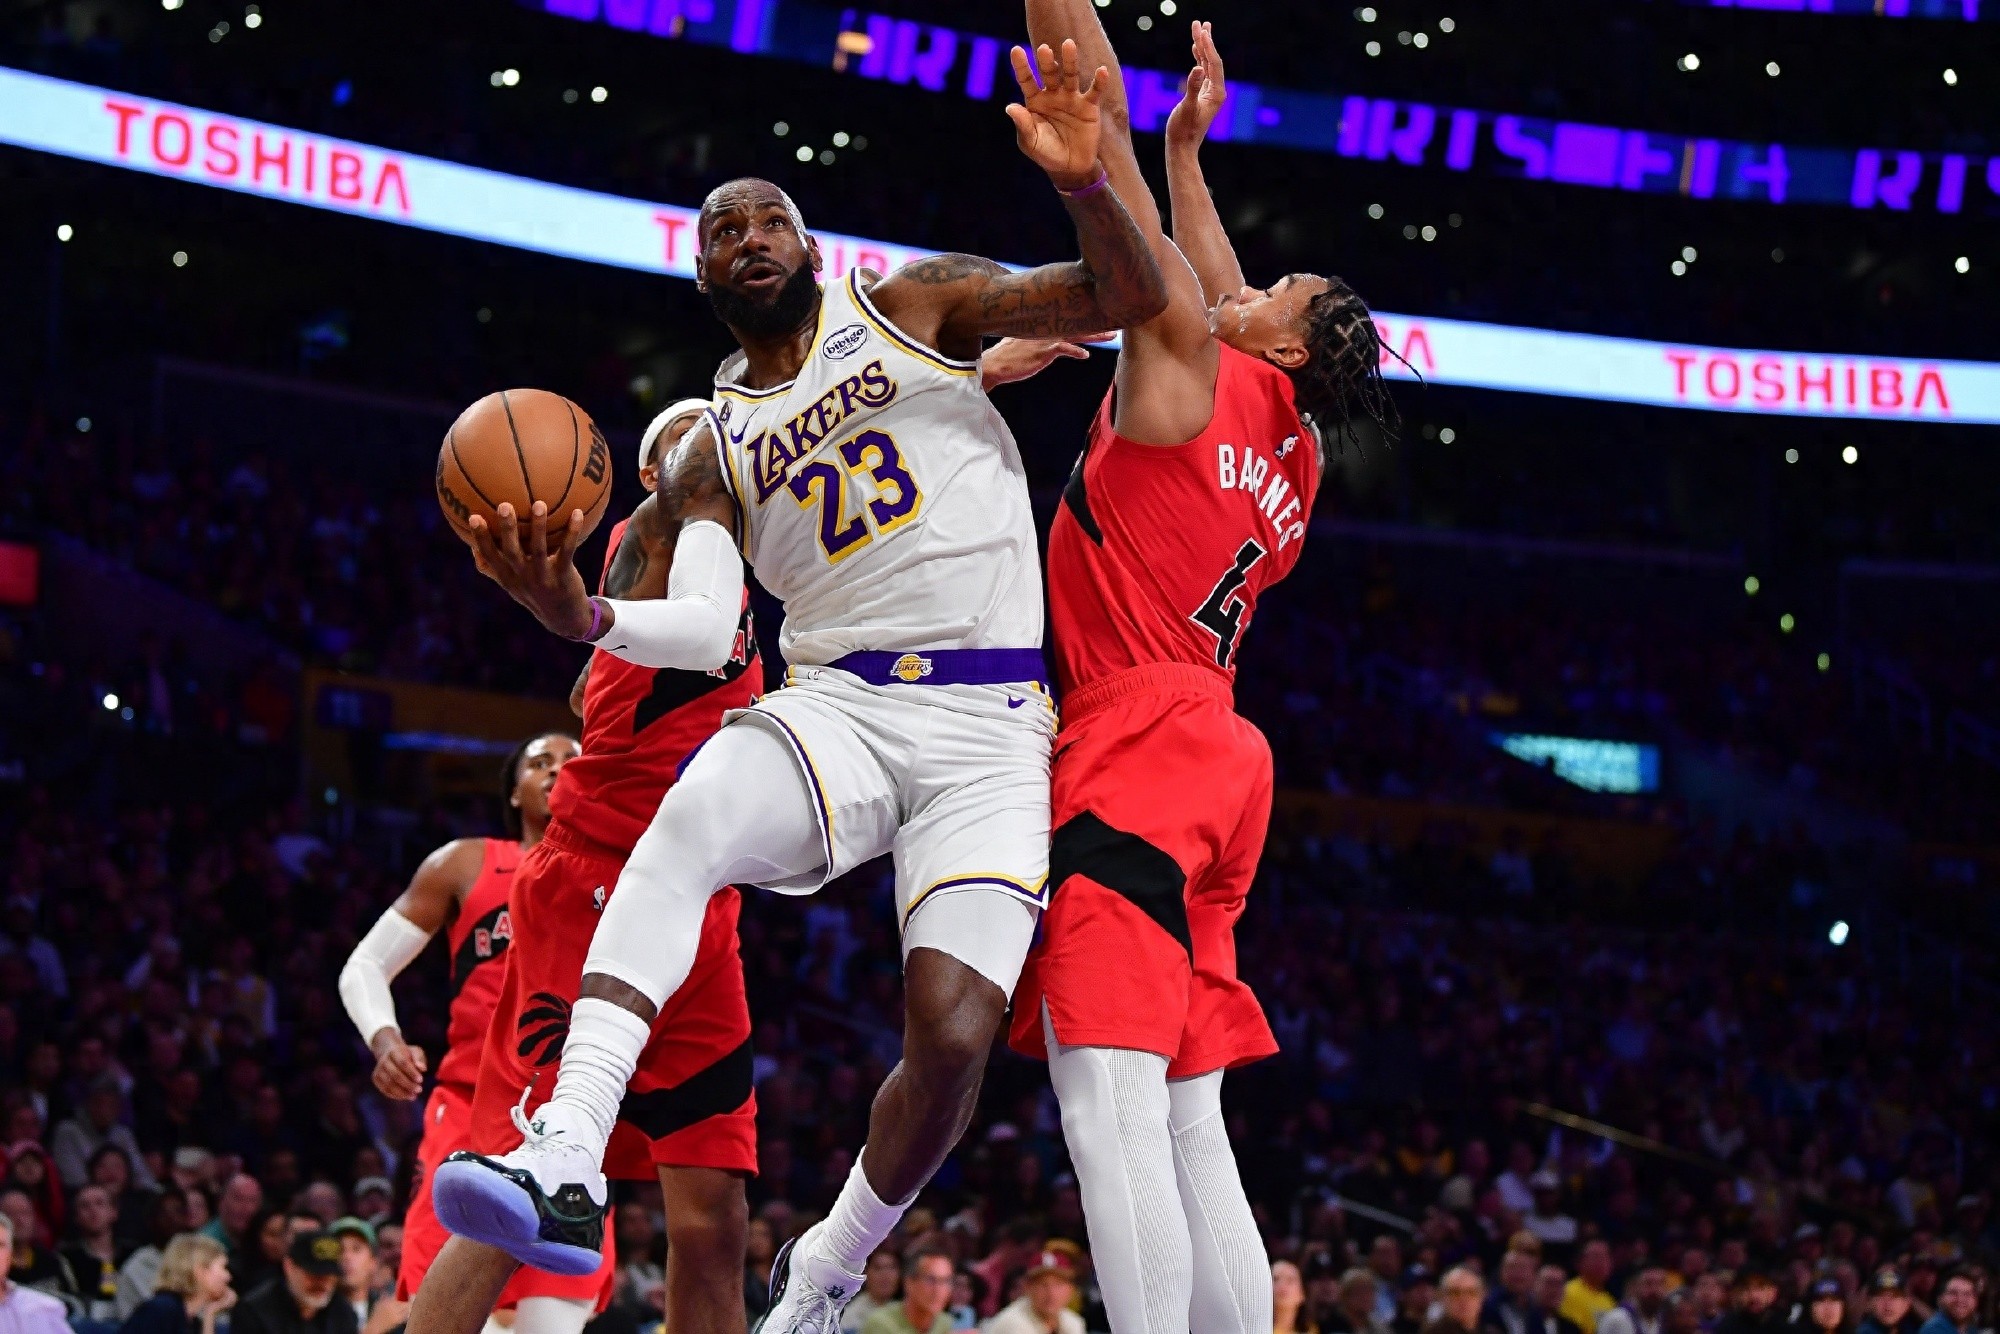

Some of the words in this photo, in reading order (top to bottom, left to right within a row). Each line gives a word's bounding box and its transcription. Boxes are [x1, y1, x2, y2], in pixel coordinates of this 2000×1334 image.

[104, 101, 411, 212] TOSHIBA
[826, 328, 864, 354] bibigo
[1666, 352, 1950, 412] TOSHIBA
[746, 358, 898, 507] LAKERS
[786, 427, 924, 565] 23
[1217, 444, 1304, 551] BARNES
[1188, 537, 1268, 670] 4
[892, 661, 932, 675] LAKERS
